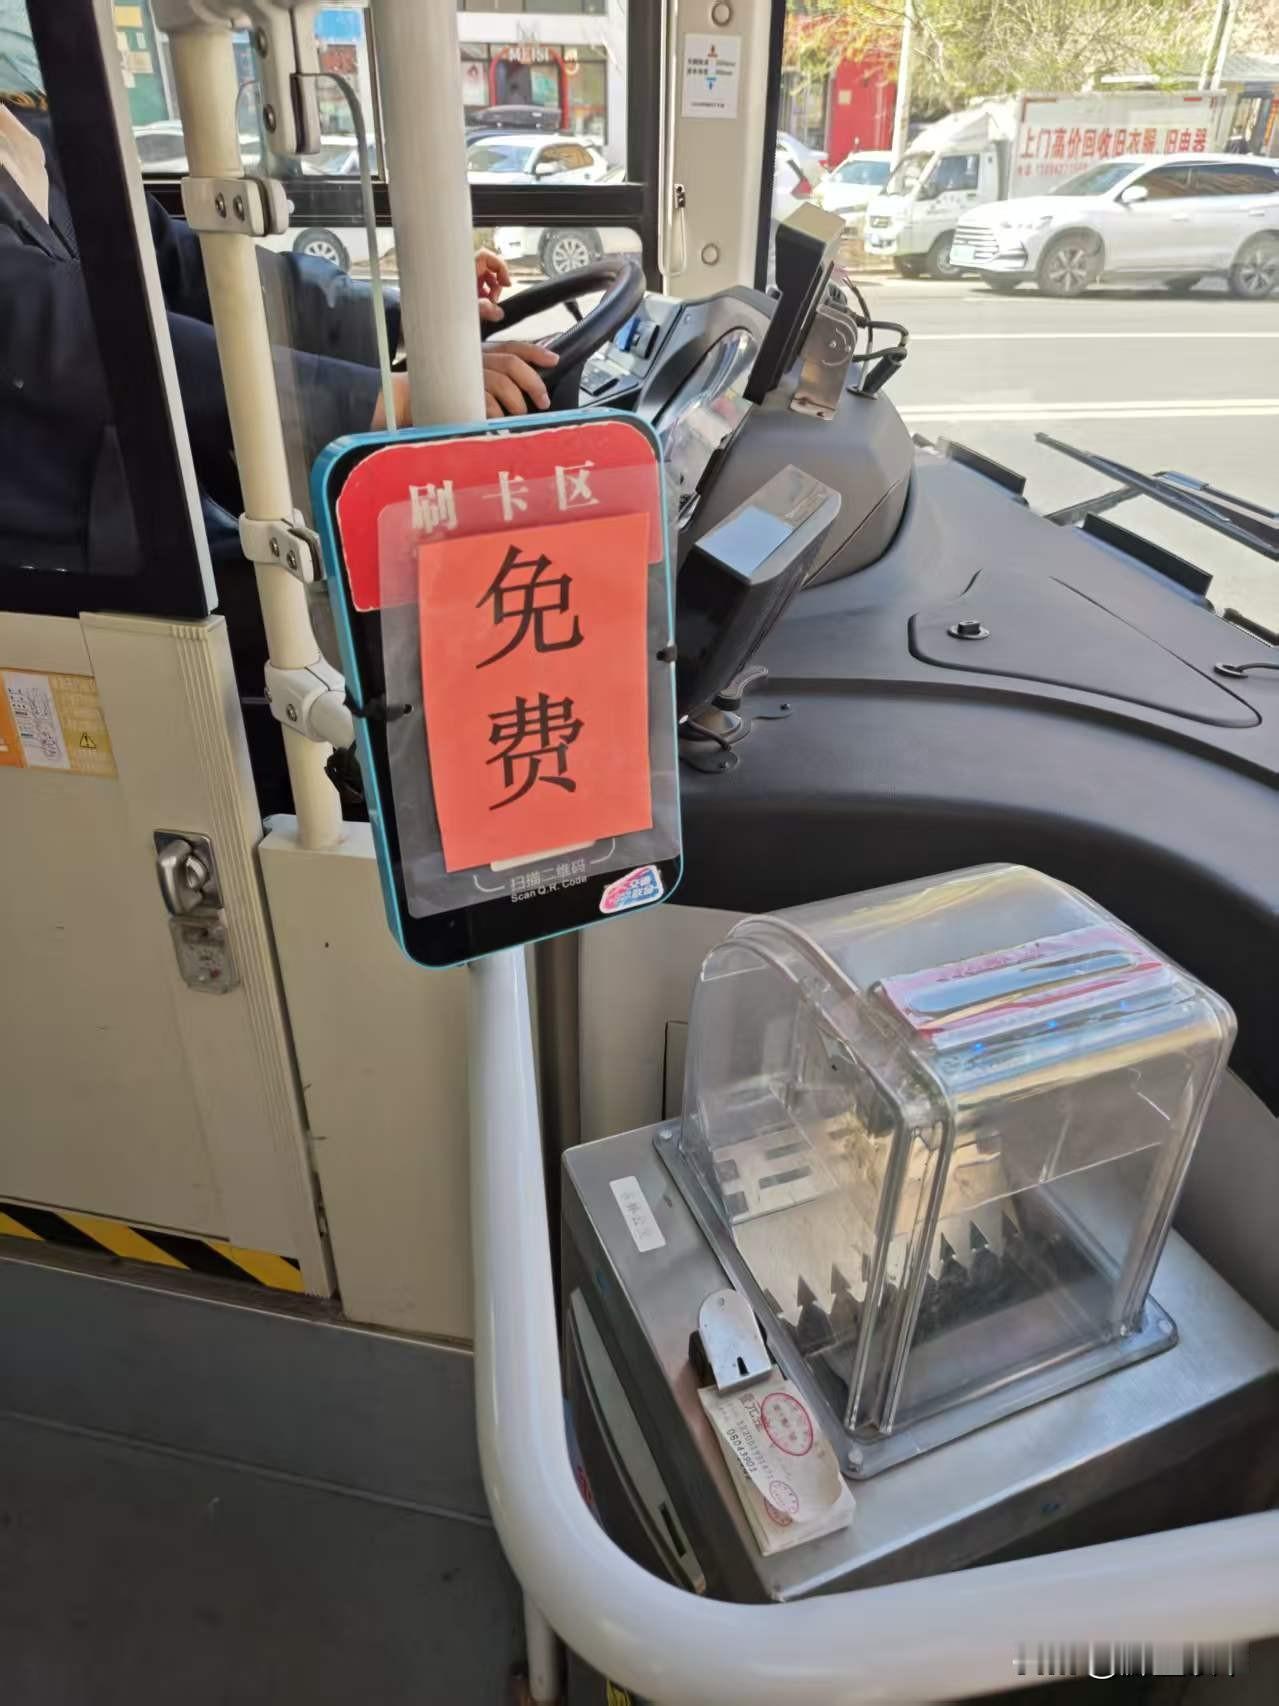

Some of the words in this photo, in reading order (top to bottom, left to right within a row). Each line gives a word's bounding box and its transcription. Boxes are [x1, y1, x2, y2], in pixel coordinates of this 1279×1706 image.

[408, 460, 600, 534] 刷卡区
[475, 544, 585, 811] 免费
[511, 859, 586, 890] 扫描二维码
[511, 888, 537, 903] Scan
[562, 875, 588, 889] Code
